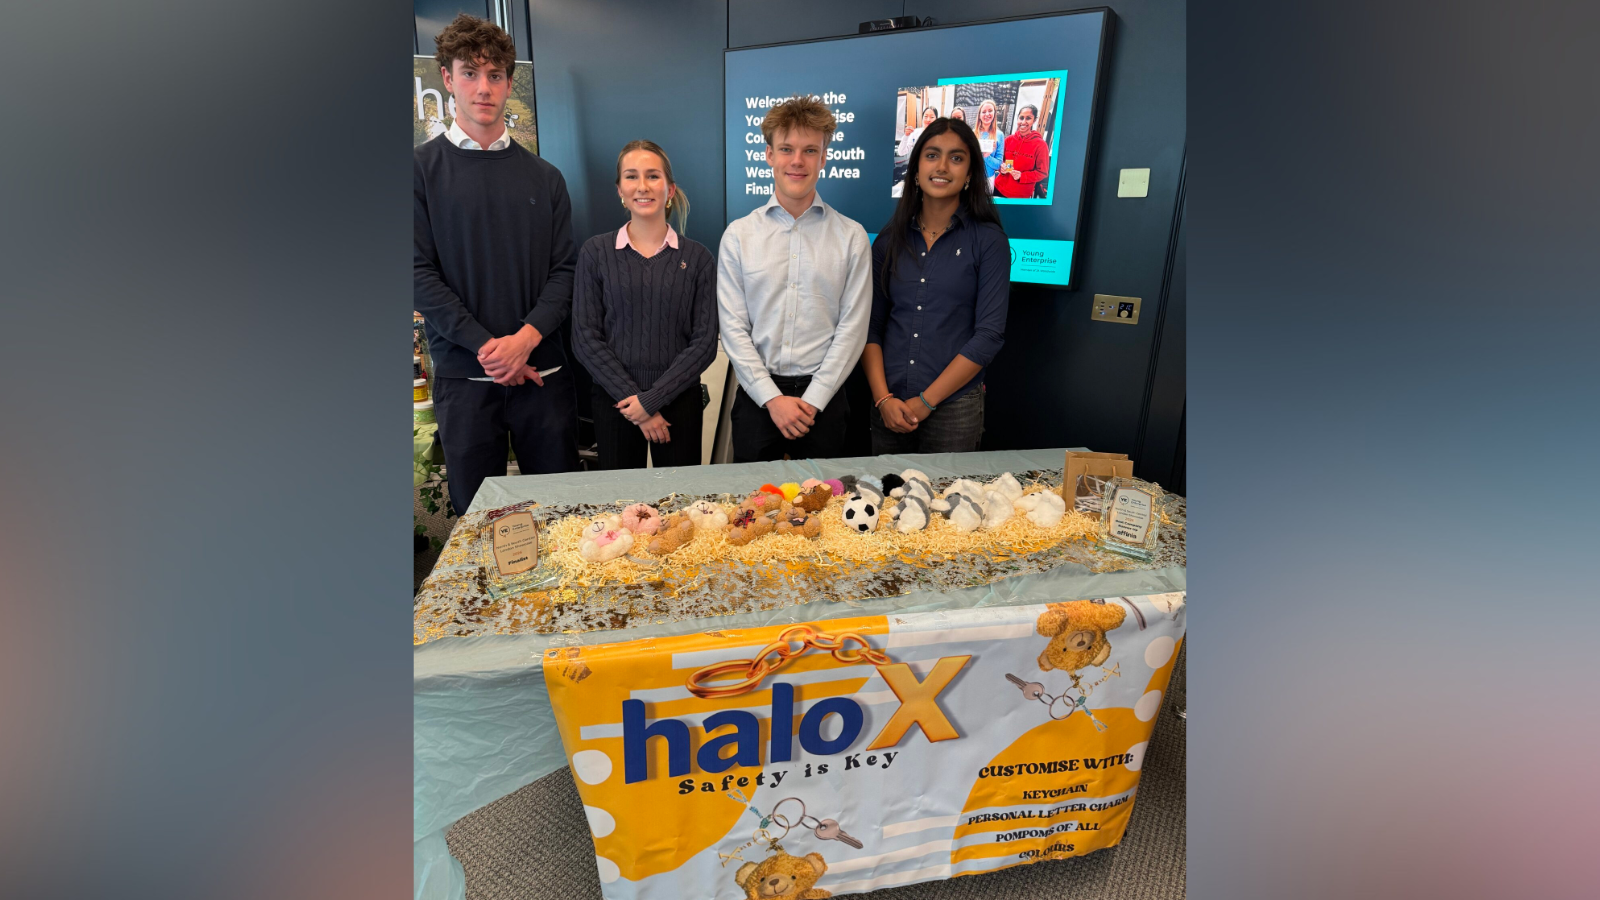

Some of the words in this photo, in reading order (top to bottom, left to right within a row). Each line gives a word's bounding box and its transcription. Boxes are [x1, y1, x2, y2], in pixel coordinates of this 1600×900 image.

[823, 91, 847, 105] the
[745, 149, 767, 161] Yea
[826, 147, 865, 160] South
[828, 166, 860, 178] Area
[678, 770, 788, 795] Safety
[804, 763, 829, 778] is
[844, 751, 899, 770] Key
[978, 759, 1080, 779] CUSTOMISE
[1083, 752, 1134, 770] WITH:
[1022, 784, 1089, 800] KEYCHAIN
[967, 810, 1036, 825] PERSONAL
[1038, 802, 1087, 819] LETTER
[1089, 794, 1129, 812] CHARM
[995, 826, 1055, 843] POMPOMS
[1056, 822, 1074, 834] OF
[1075, 822, 1101, 831] ALL
